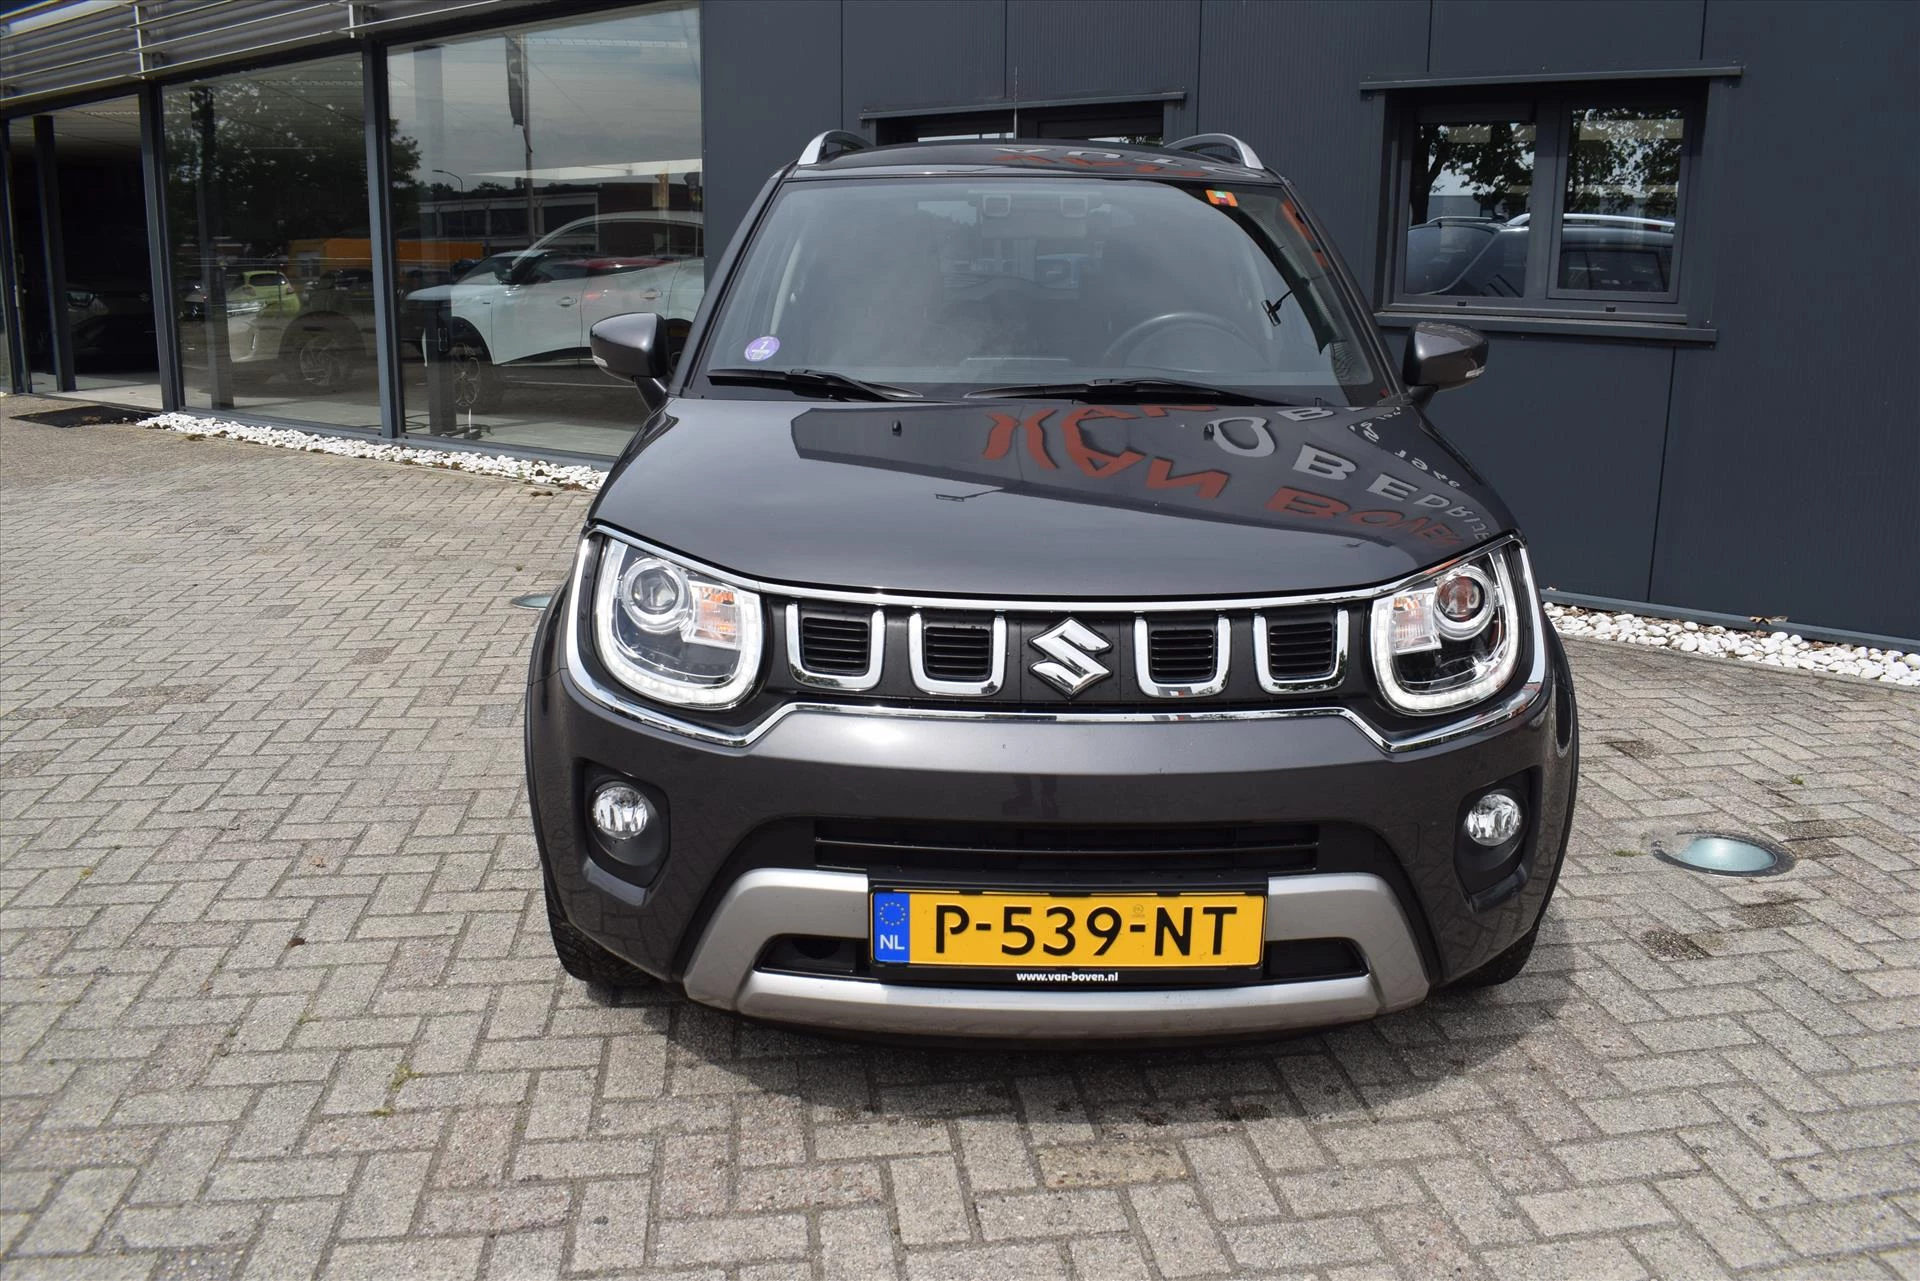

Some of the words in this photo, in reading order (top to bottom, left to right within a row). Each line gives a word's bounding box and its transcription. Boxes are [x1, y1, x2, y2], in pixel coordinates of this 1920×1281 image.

[935, 904, 1238, 957] P-539-NT
[879, 934, 905, 951] NL
[1016, 971, 1119, 983] www.van-boven.nl
